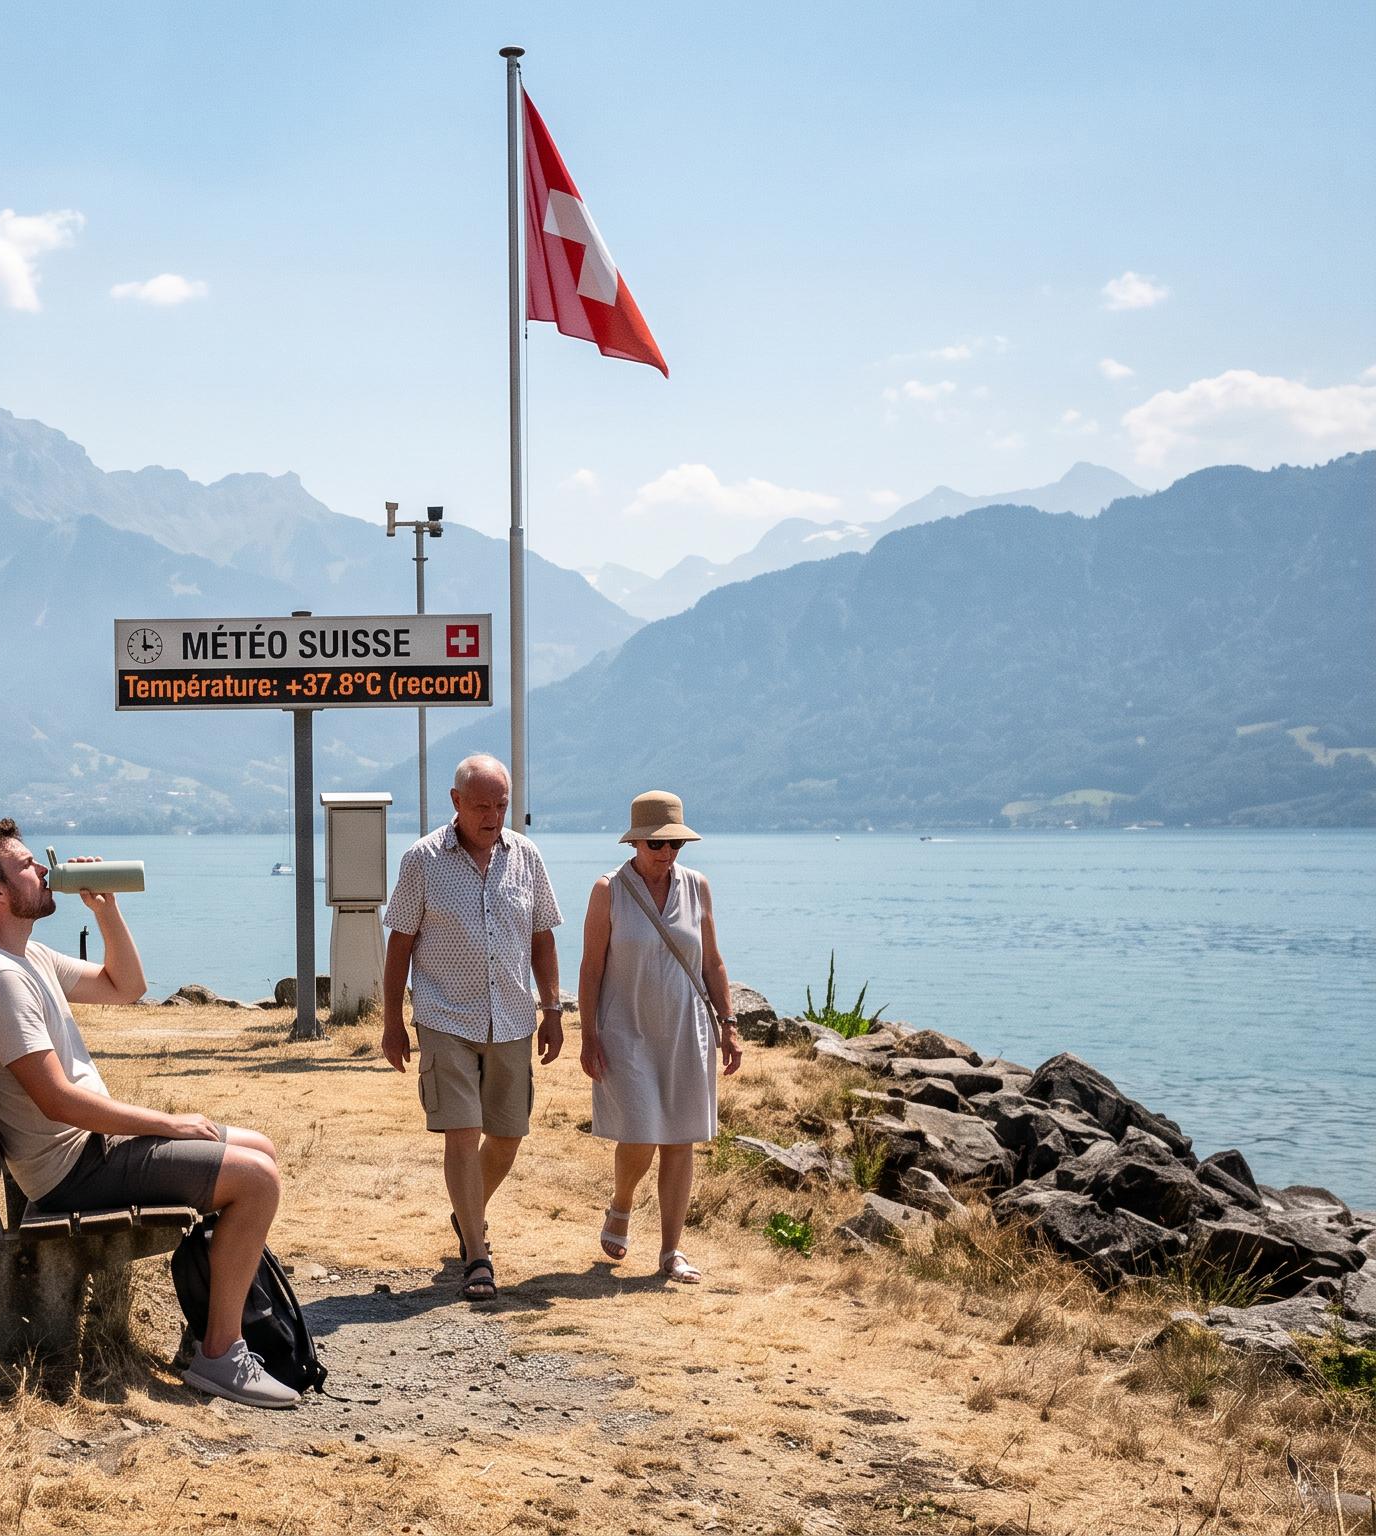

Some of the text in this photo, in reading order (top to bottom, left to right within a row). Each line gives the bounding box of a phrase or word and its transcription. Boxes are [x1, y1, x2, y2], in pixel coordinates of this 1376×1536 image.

[181, 623, 411, 660] MÉTÉO SUISSE
[124, 670, 482, 703] Température: +37.8°C (record)
